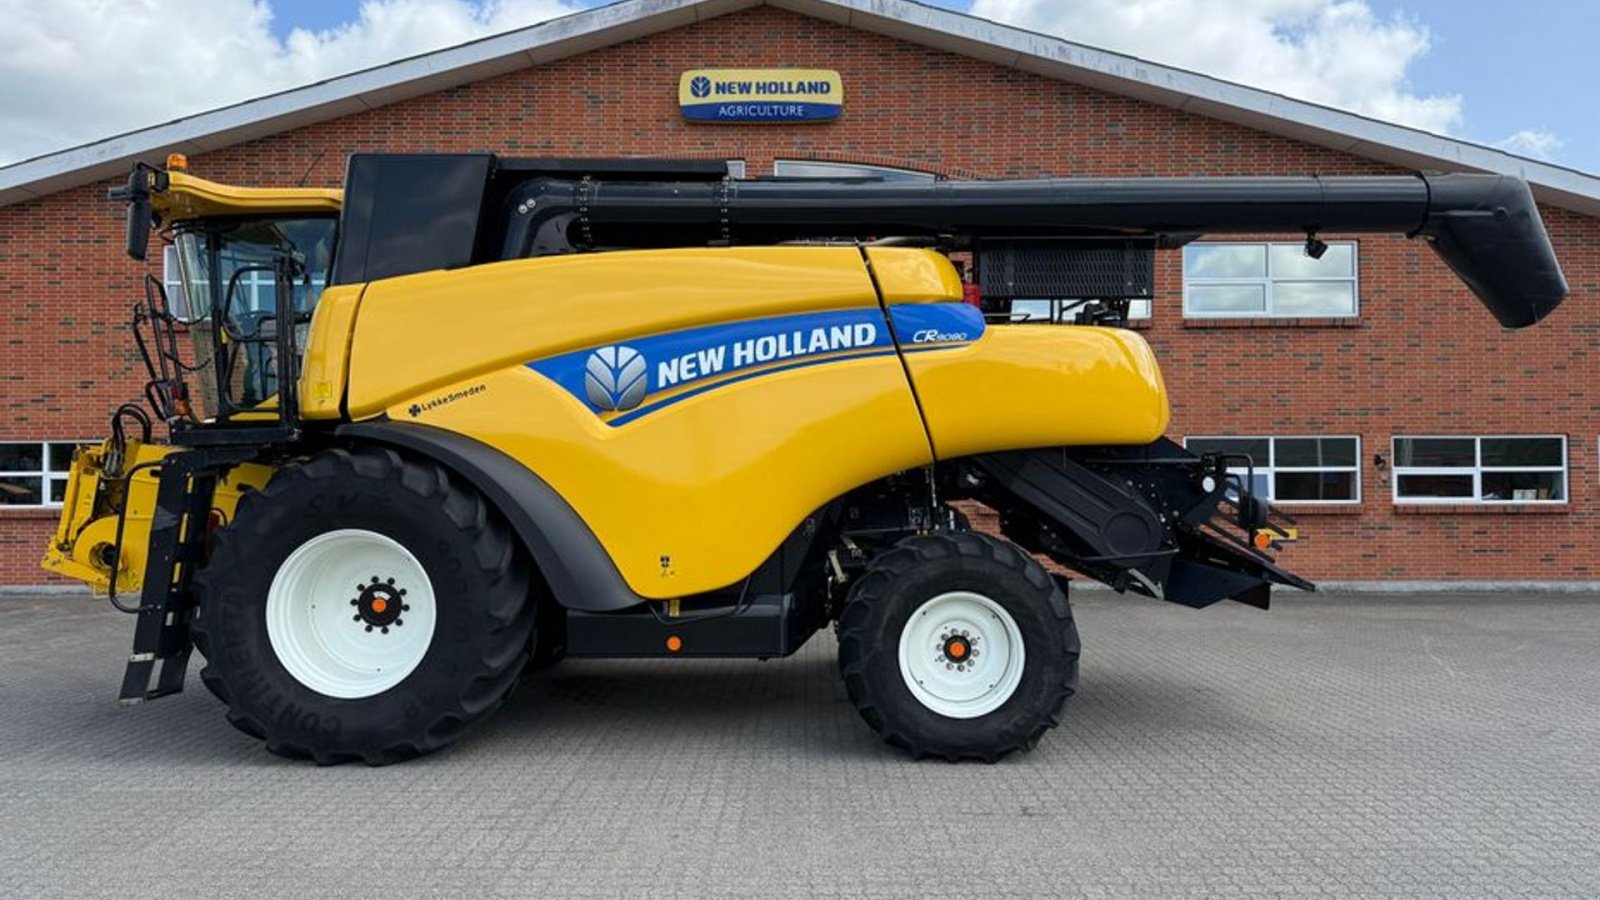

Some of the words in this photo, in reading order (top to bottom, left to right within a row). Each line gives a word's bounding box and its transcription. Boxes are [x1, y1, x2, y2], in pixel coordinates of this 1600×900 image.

[715, 81, 752, 95] NEW
[755, 81, 831, 95] HOLLAND
[719, 105, 804, 117] AGRICULTURE
[658, 345, 725, 389] NEW
[733, 322, 877, 367] HOLLAND
